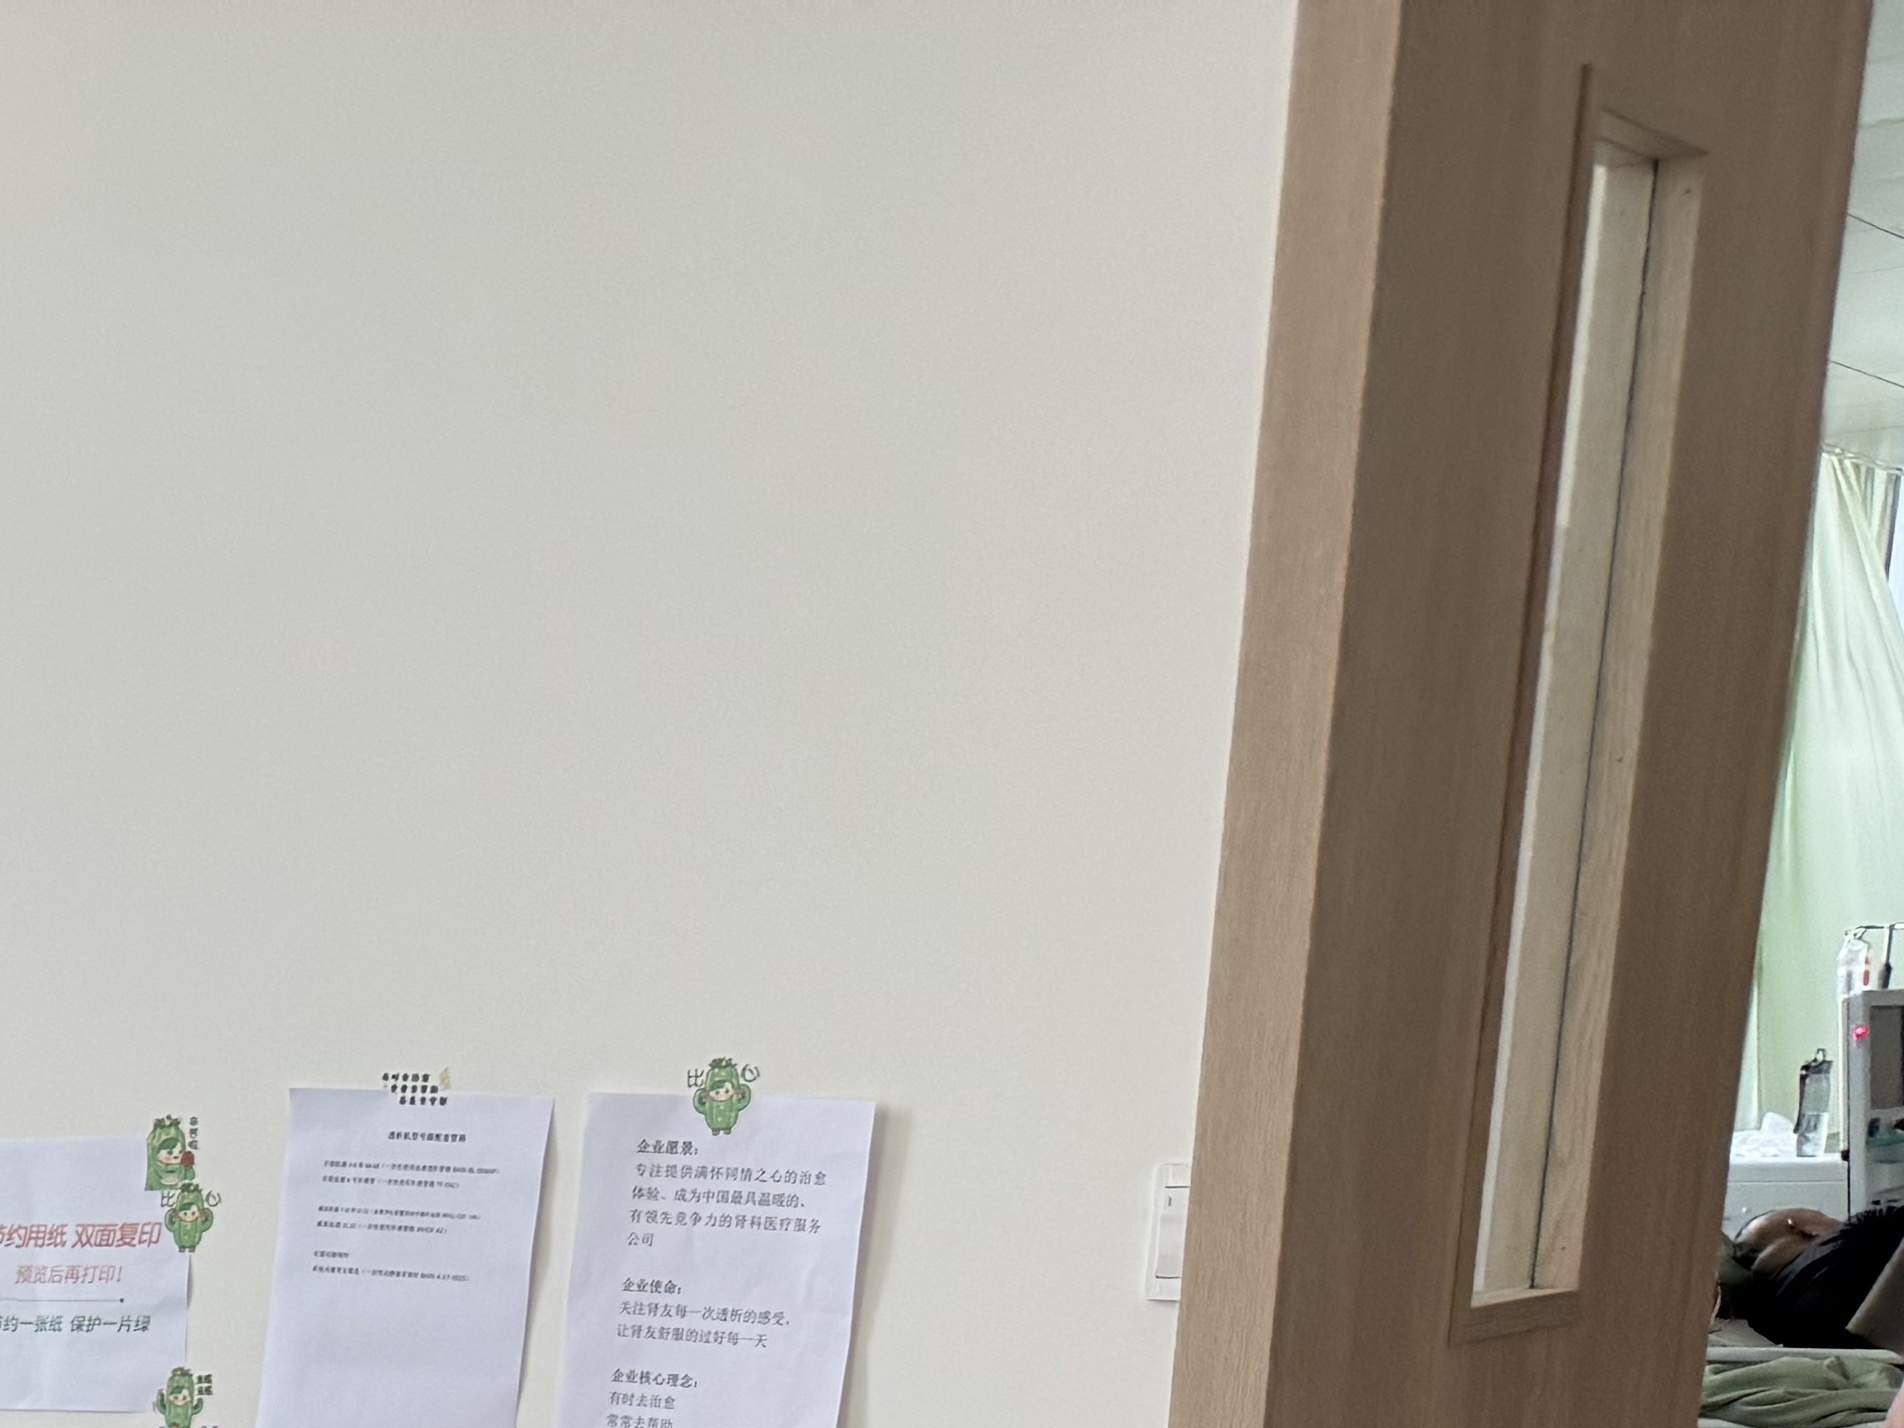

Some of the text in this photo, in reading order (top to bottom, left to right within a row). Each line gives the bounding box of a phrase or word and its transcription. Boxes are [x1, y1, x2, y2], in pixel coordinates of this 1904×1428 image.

[71, 1221, 162, 1248] 双面复印
[627, 1232, 654, 1247] 公司
[70, 1315, 152, 1333] 保护一片绿
